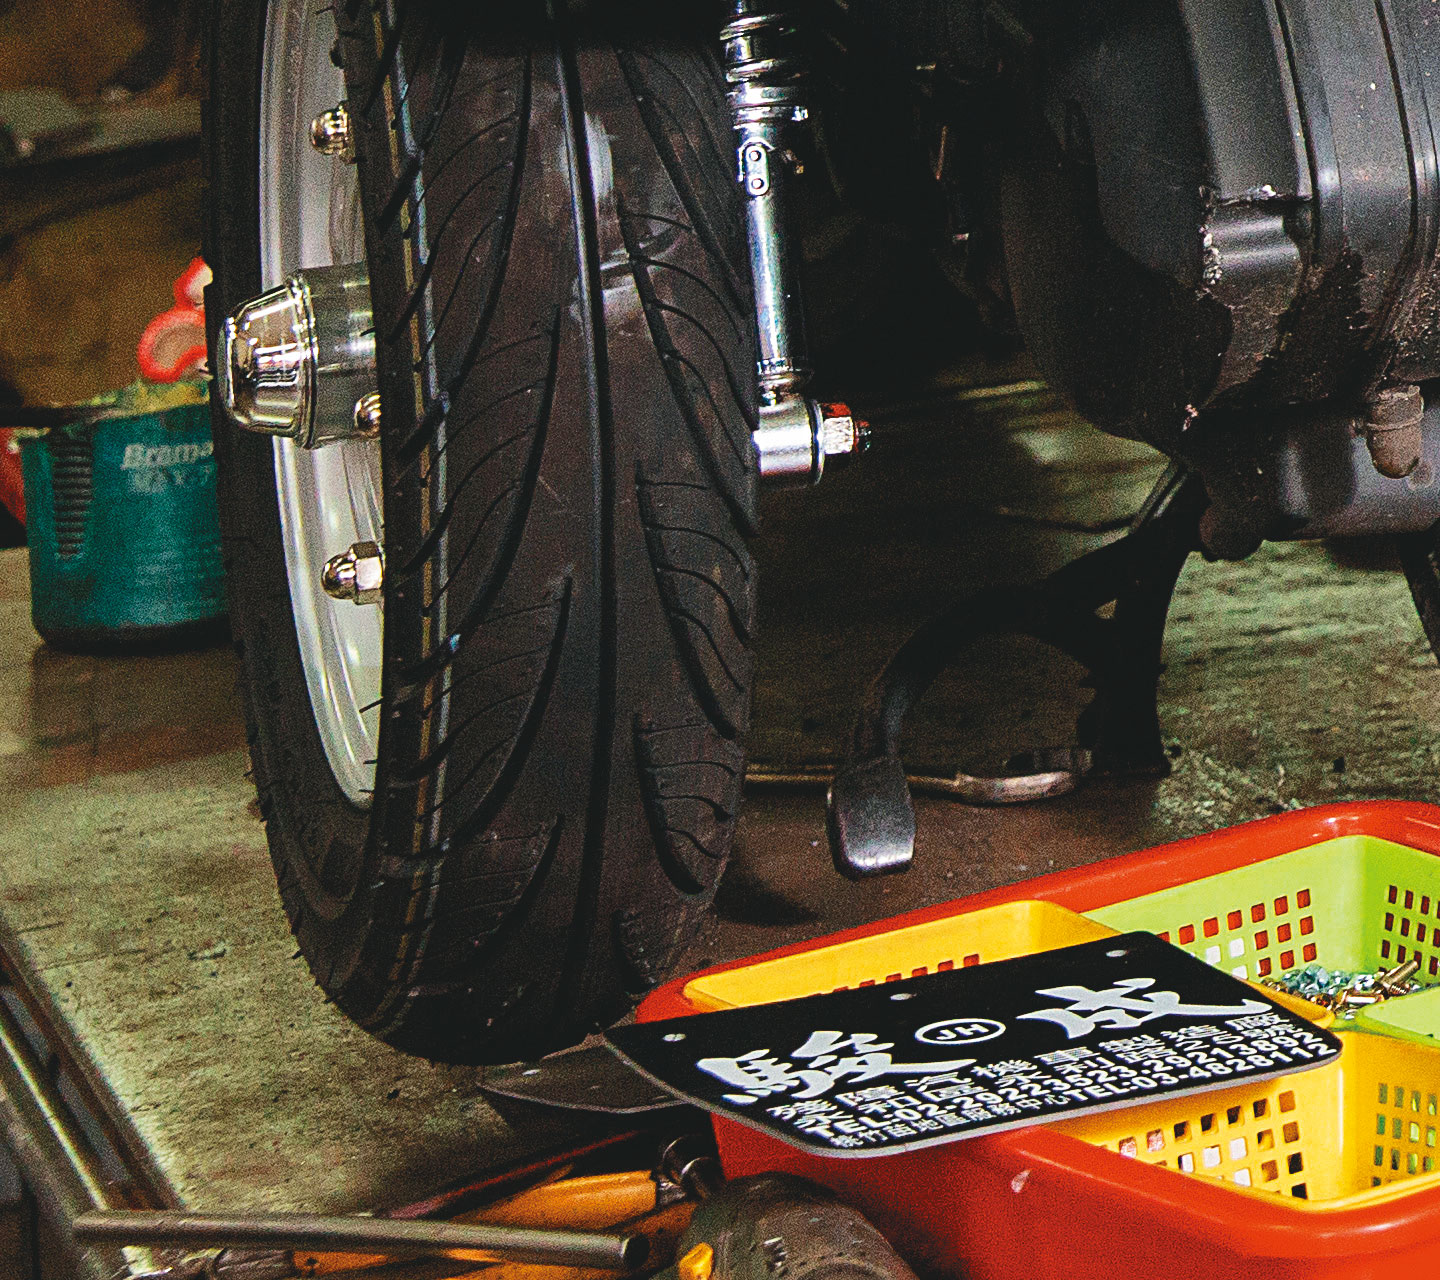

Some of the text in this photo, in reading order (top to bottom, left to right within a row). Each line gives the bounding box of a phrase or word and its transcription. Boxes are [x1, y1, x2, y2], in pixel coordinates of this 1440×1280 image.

[696, 977, 1273, 1107] 駿 JH 成
